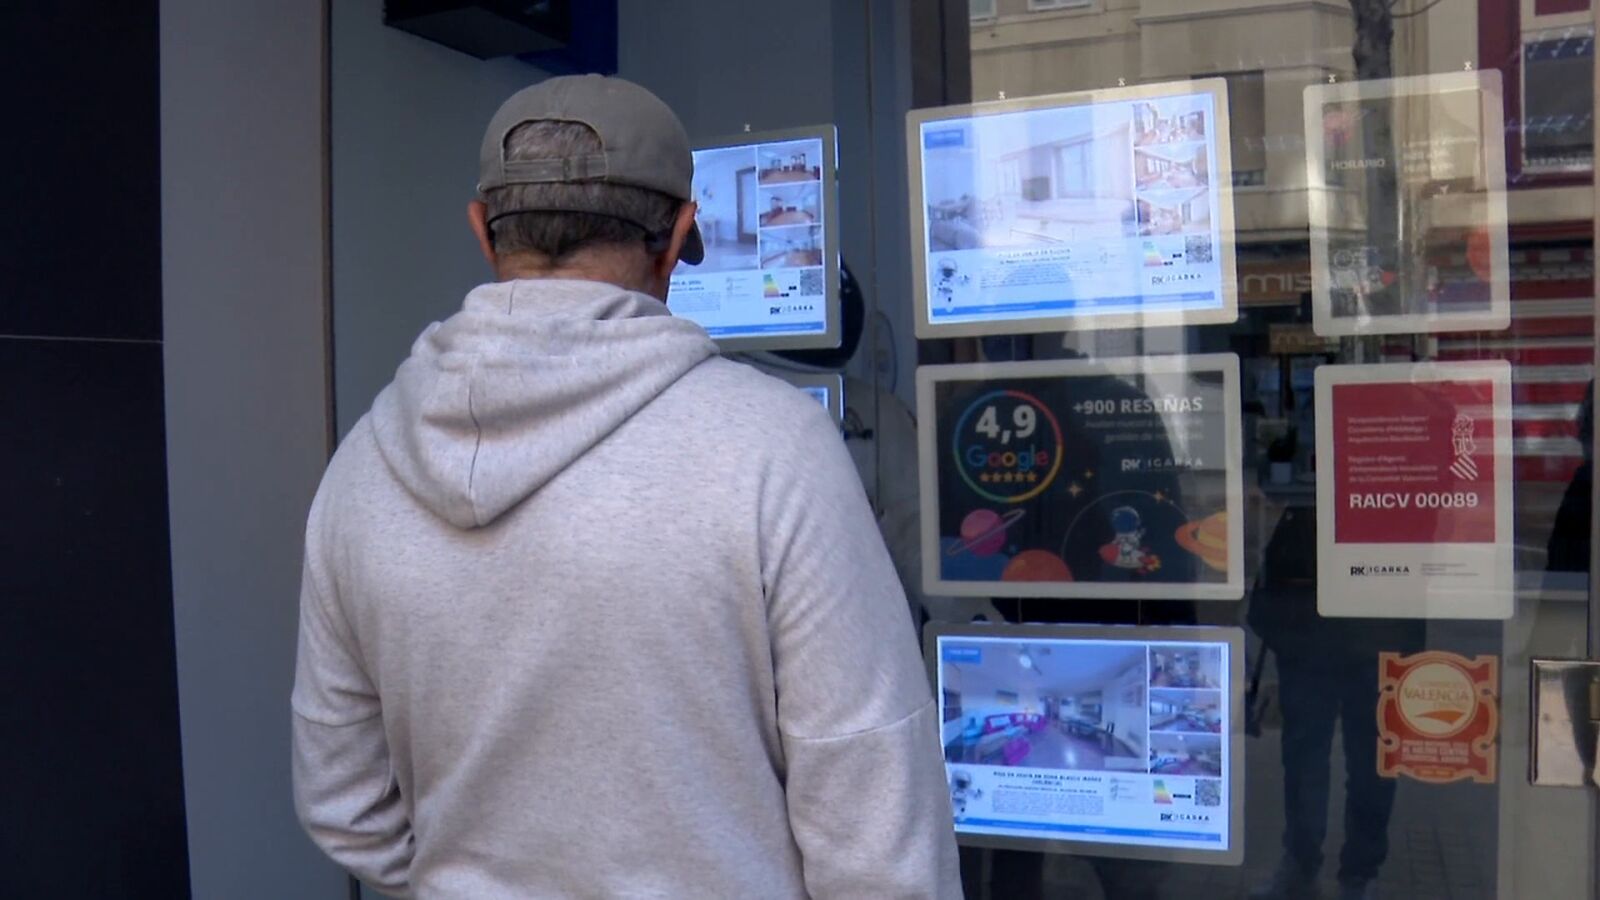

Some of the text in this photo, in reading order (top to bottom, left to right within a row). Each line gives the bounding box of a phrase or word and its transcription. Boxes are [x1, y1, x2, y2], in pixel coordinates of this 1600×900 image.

[1073, 394, 1203, 415] +900 RESEÑAS
[975, 404, 1037, 444] 4,9
[966, 445, 1049, 471] Google
[1350, 492, 1478, 508] RAICV 00089
[1350, 566, 1365, 576] RK
[1404, 687, 1470, 701] VALENCIA
